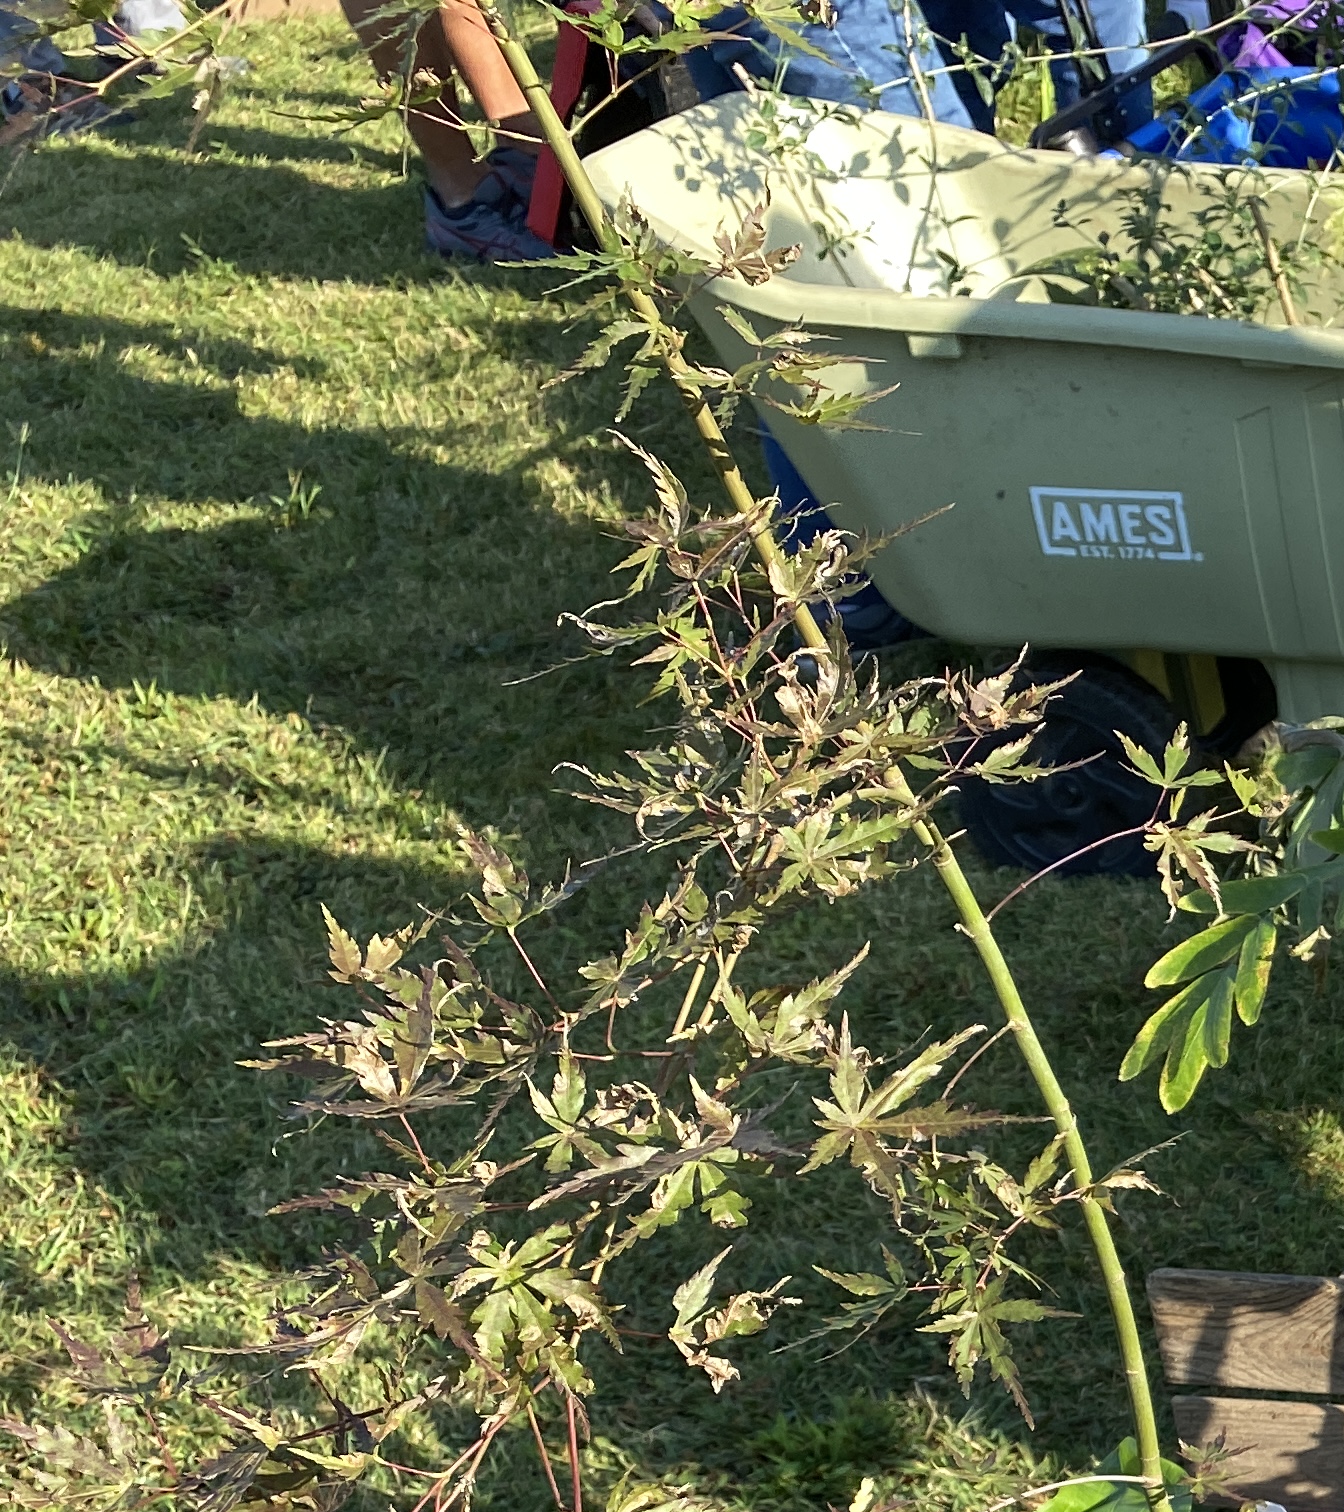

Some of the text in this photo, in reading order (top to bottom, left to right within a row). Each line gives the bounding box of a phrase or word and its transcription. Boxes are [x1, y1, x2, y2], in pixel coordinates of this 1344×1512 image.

[1051, 501, 1175, 546] AMES
[1079, 546, 1156, 560] EST. 1774
